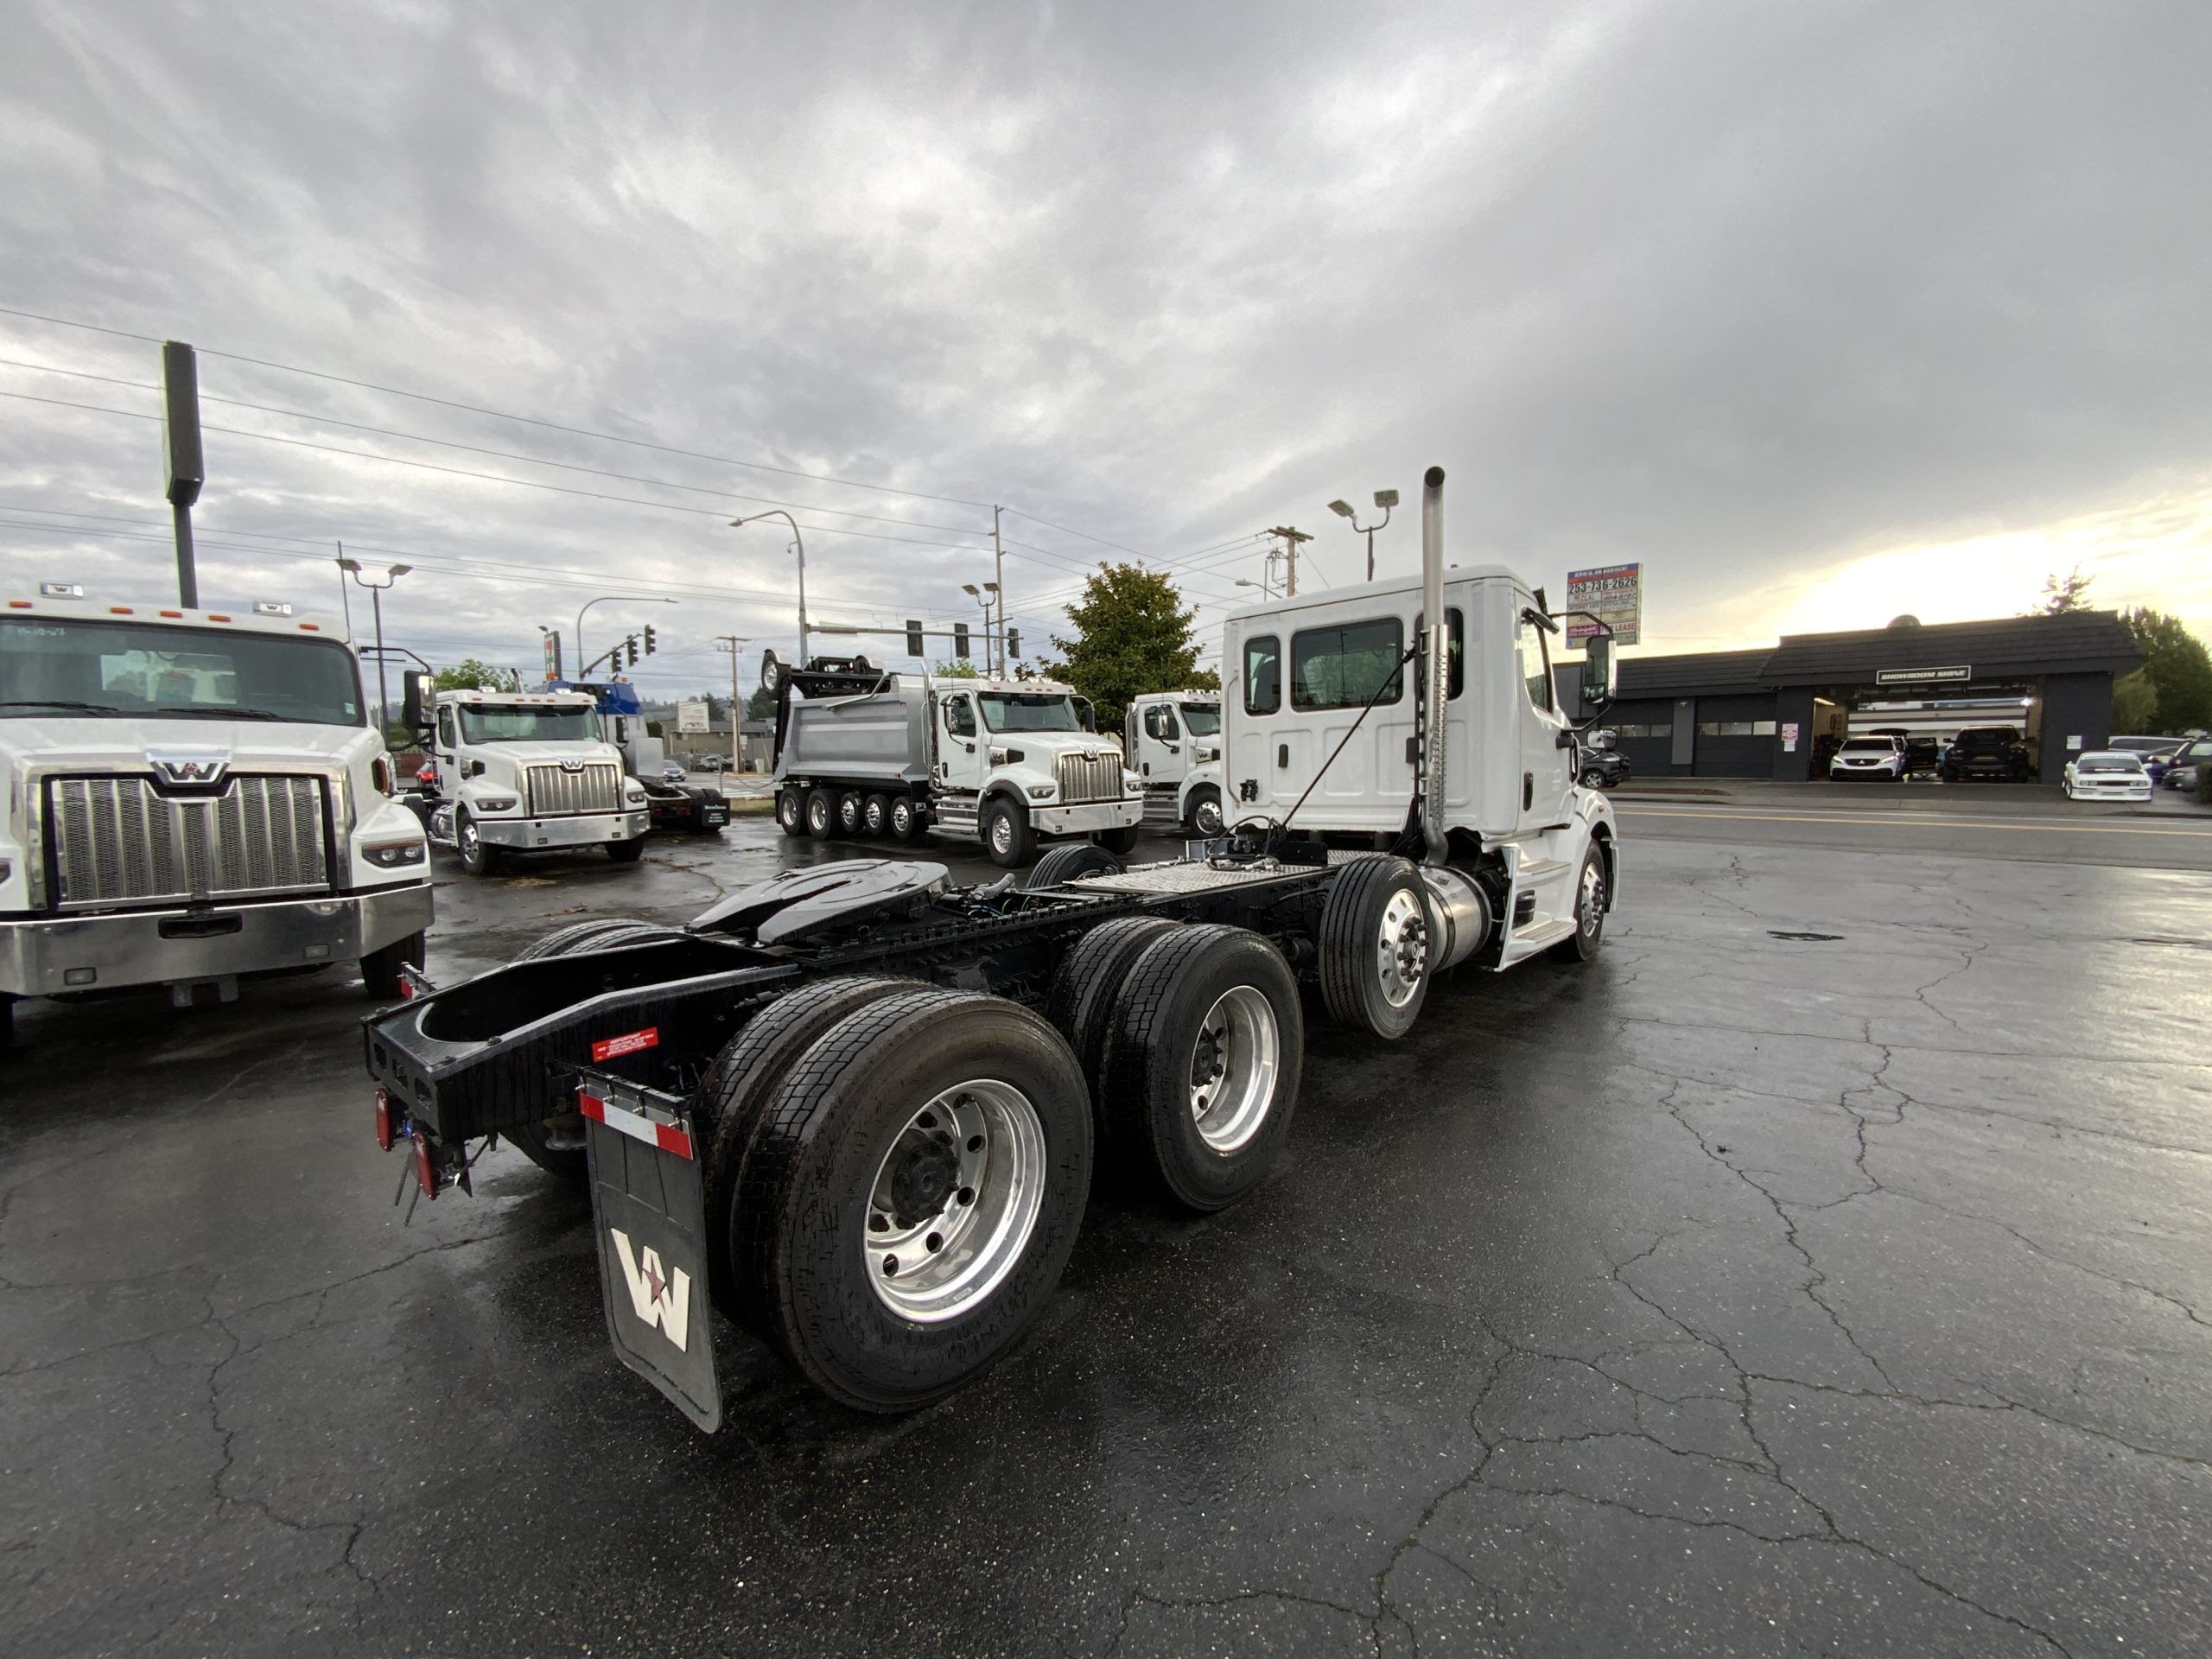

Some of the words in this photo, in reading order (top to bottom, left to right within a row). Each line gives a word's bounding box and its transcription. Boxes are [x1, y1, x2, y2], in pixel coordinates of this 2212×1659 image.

[1574, 566, 1629, 577] DELRIDGE
[1568, 576, 1637, 594] 253-736-2626
[1615, 622, 1635, 632] LEASE
